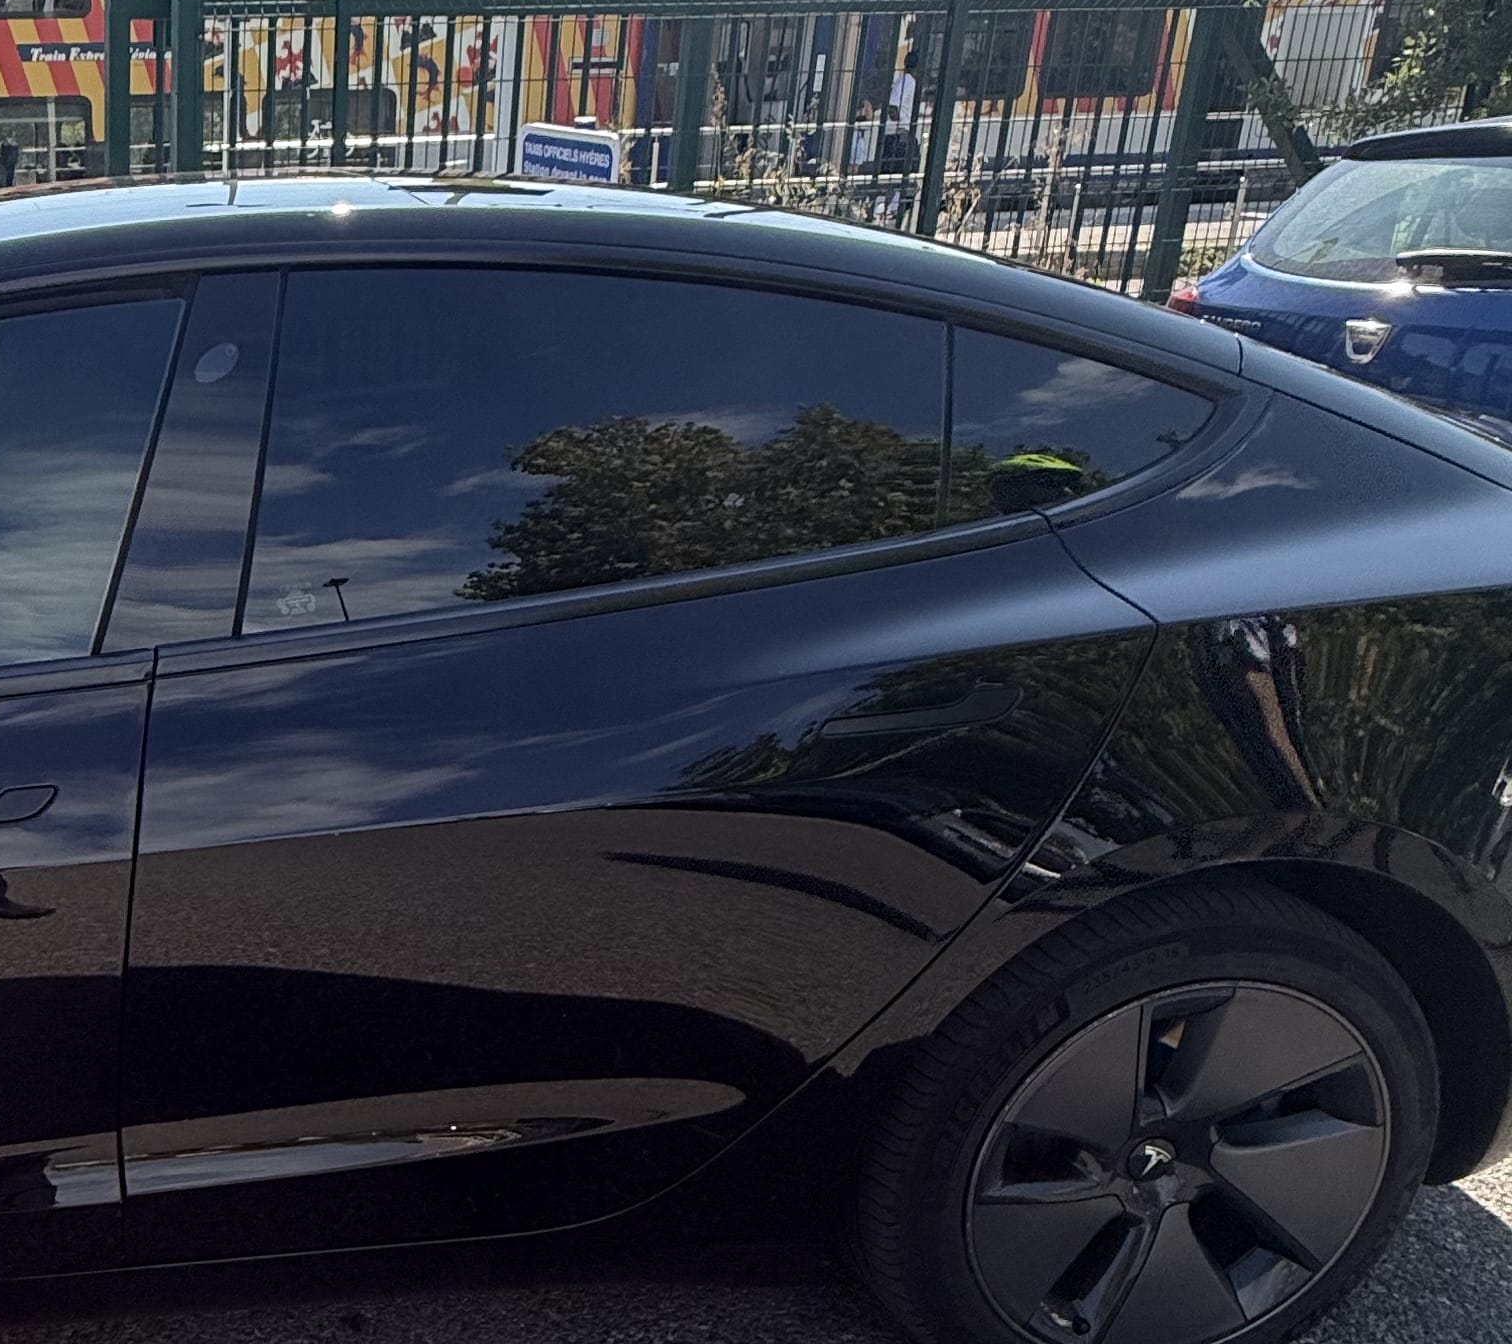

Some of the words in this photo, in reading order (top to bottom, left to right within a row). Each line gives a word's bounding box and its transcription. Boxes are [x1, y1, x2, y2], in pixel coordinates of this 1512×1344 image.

[30, 47, 67, 62] Train
[69, 46, 105, 61] Expre
[525, 142, 543, 157] TAXIS
[544, 145, 579, 163] OFFICIELS
[580, 149, 610, 168] HYÈRES
[523, 161, 550, 177] Station
